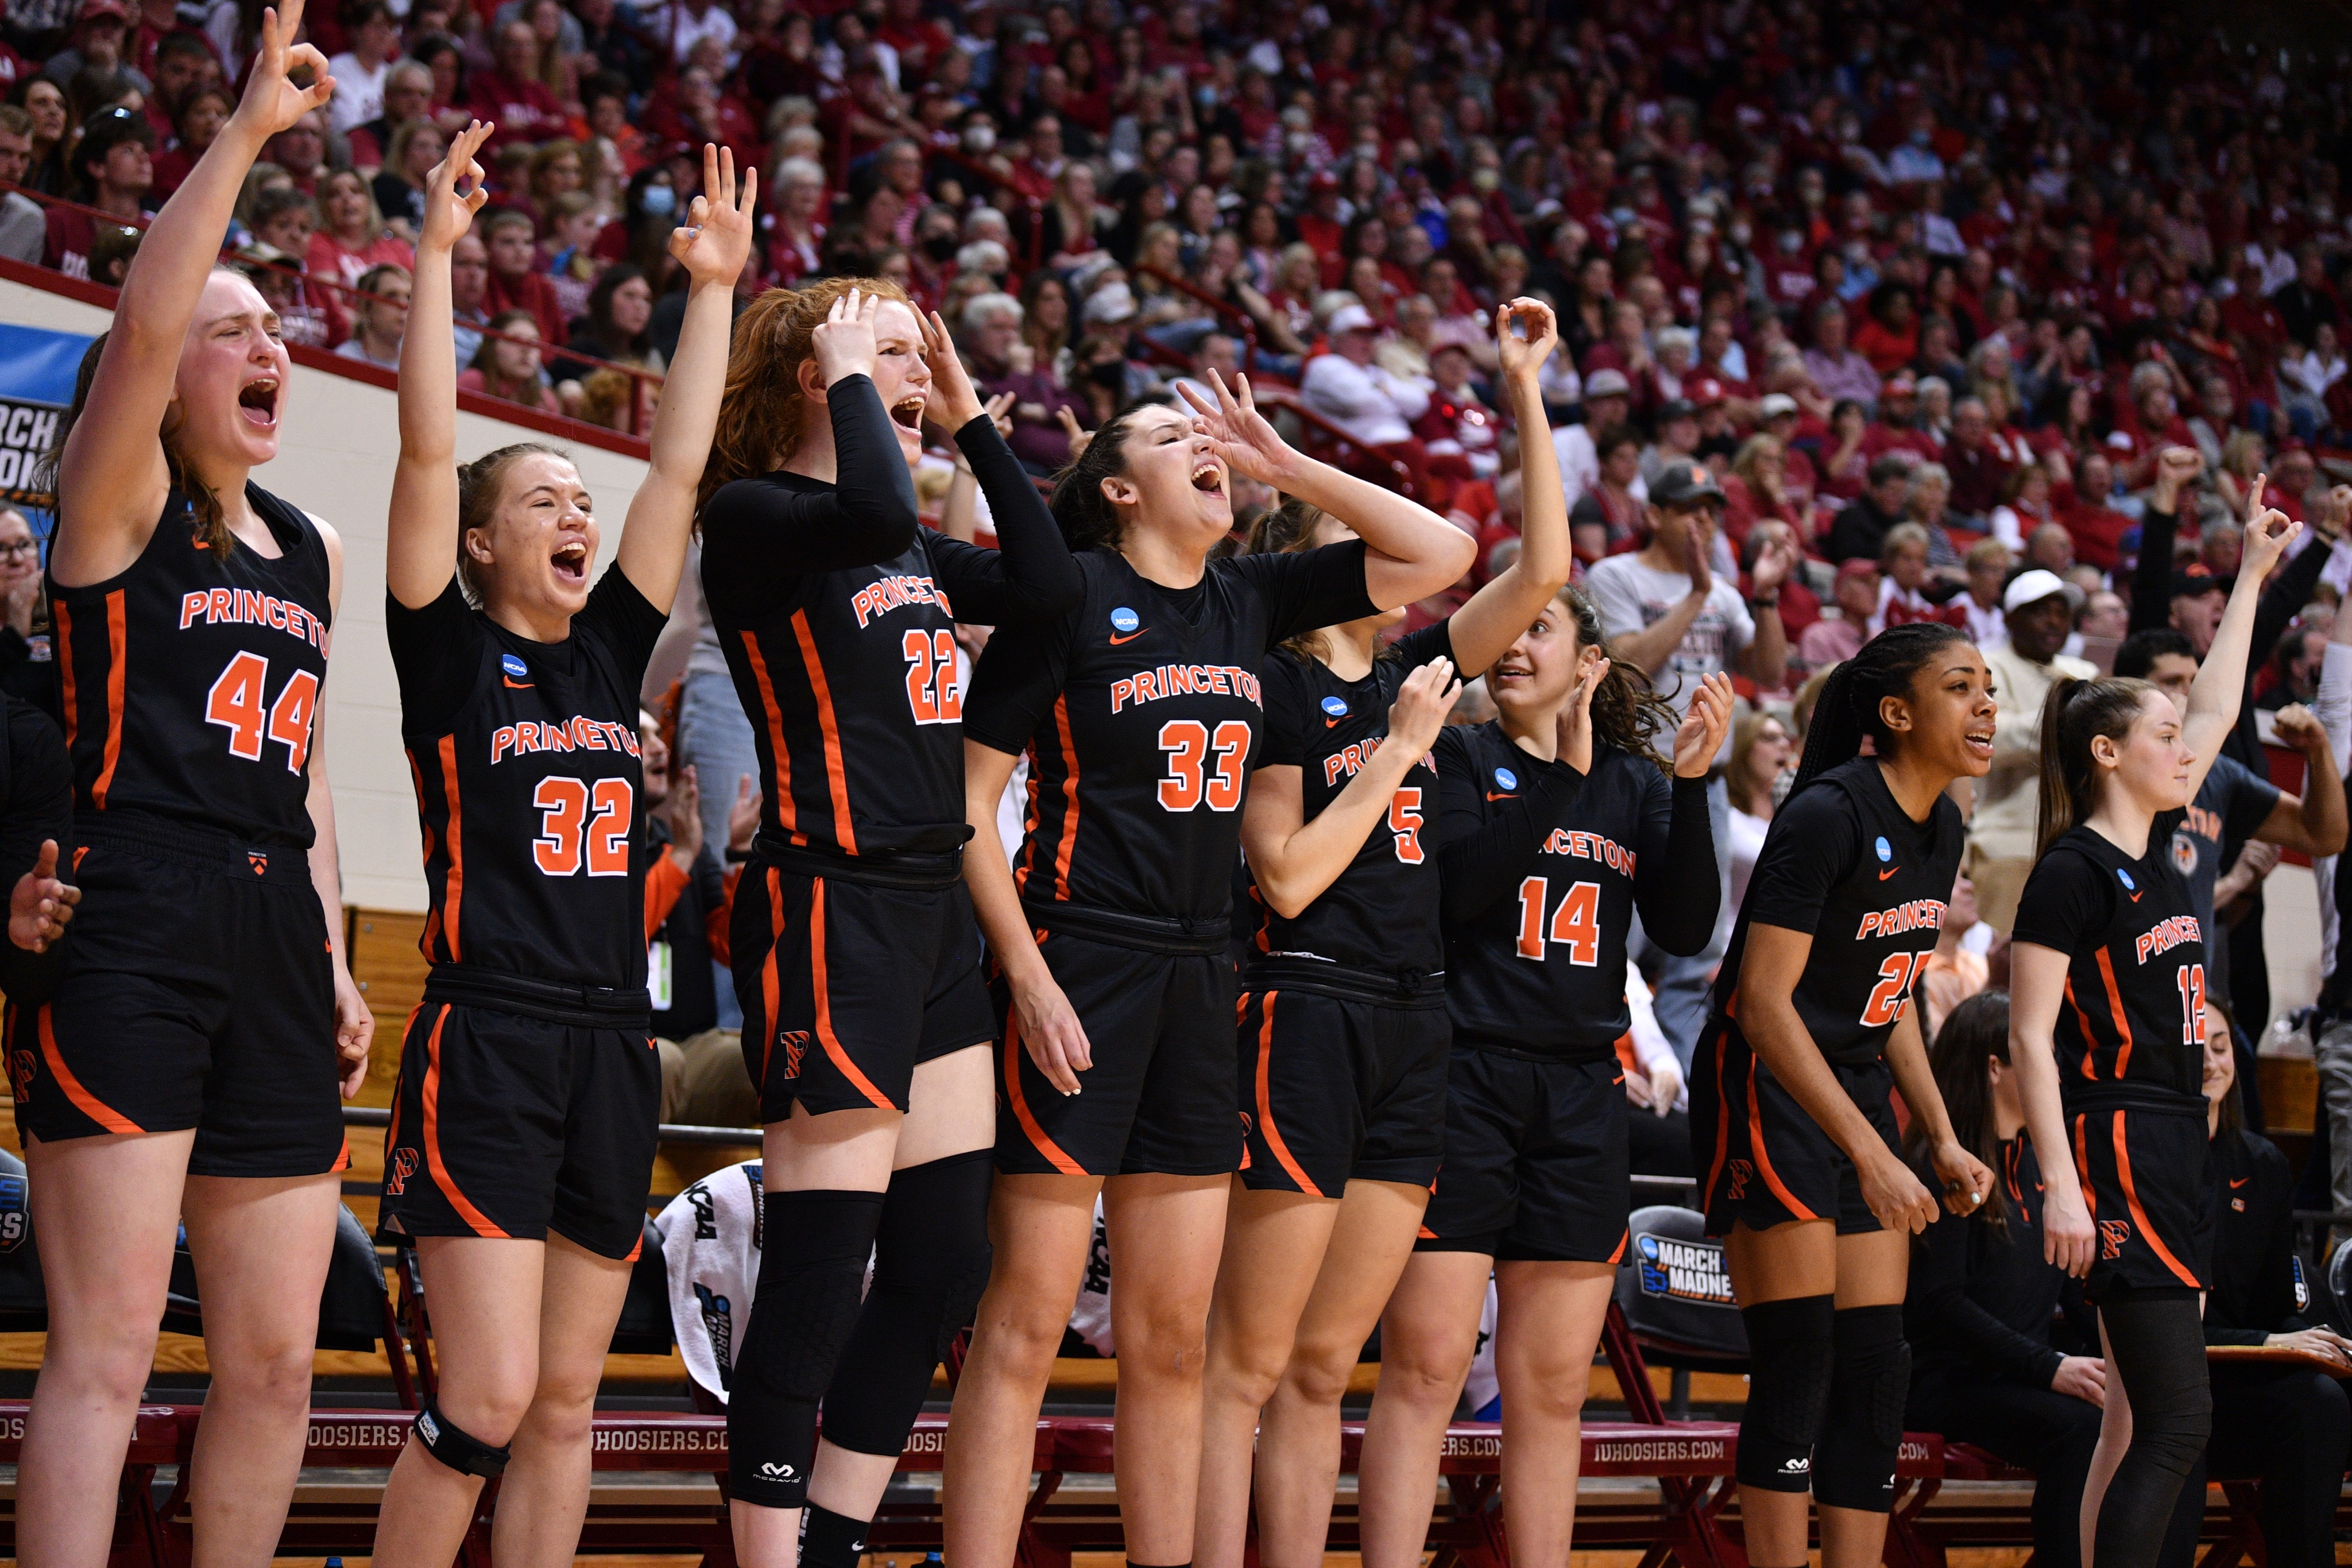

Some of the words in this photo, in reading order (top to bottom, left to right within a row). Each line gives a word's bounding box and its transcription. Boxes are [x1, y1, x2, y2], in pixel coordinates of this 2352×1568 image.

[504, 662, 527, 673] NCAA
[902, 629, 962, 725] 22
[1111, 664, 1263, 714] PRINCETON
[205, 650, 319, 776] 44
[1327, 704, 1347, 712] NCAA
[1157, 720, 1251, 812] 33
[533, 776, 633, 877] 32
[1387, 787, 1425, 865] 5
[1516, 876, 1600, 967] 14
[2177, 963, 2206, 1045] 12
[1658, 1241, 1720, 1273] MARCH
[590, 1431, 729, 1450] HOOSIERS.CO
[1594, 1441, 1724, 1462] IUHOOSIERS.COM
